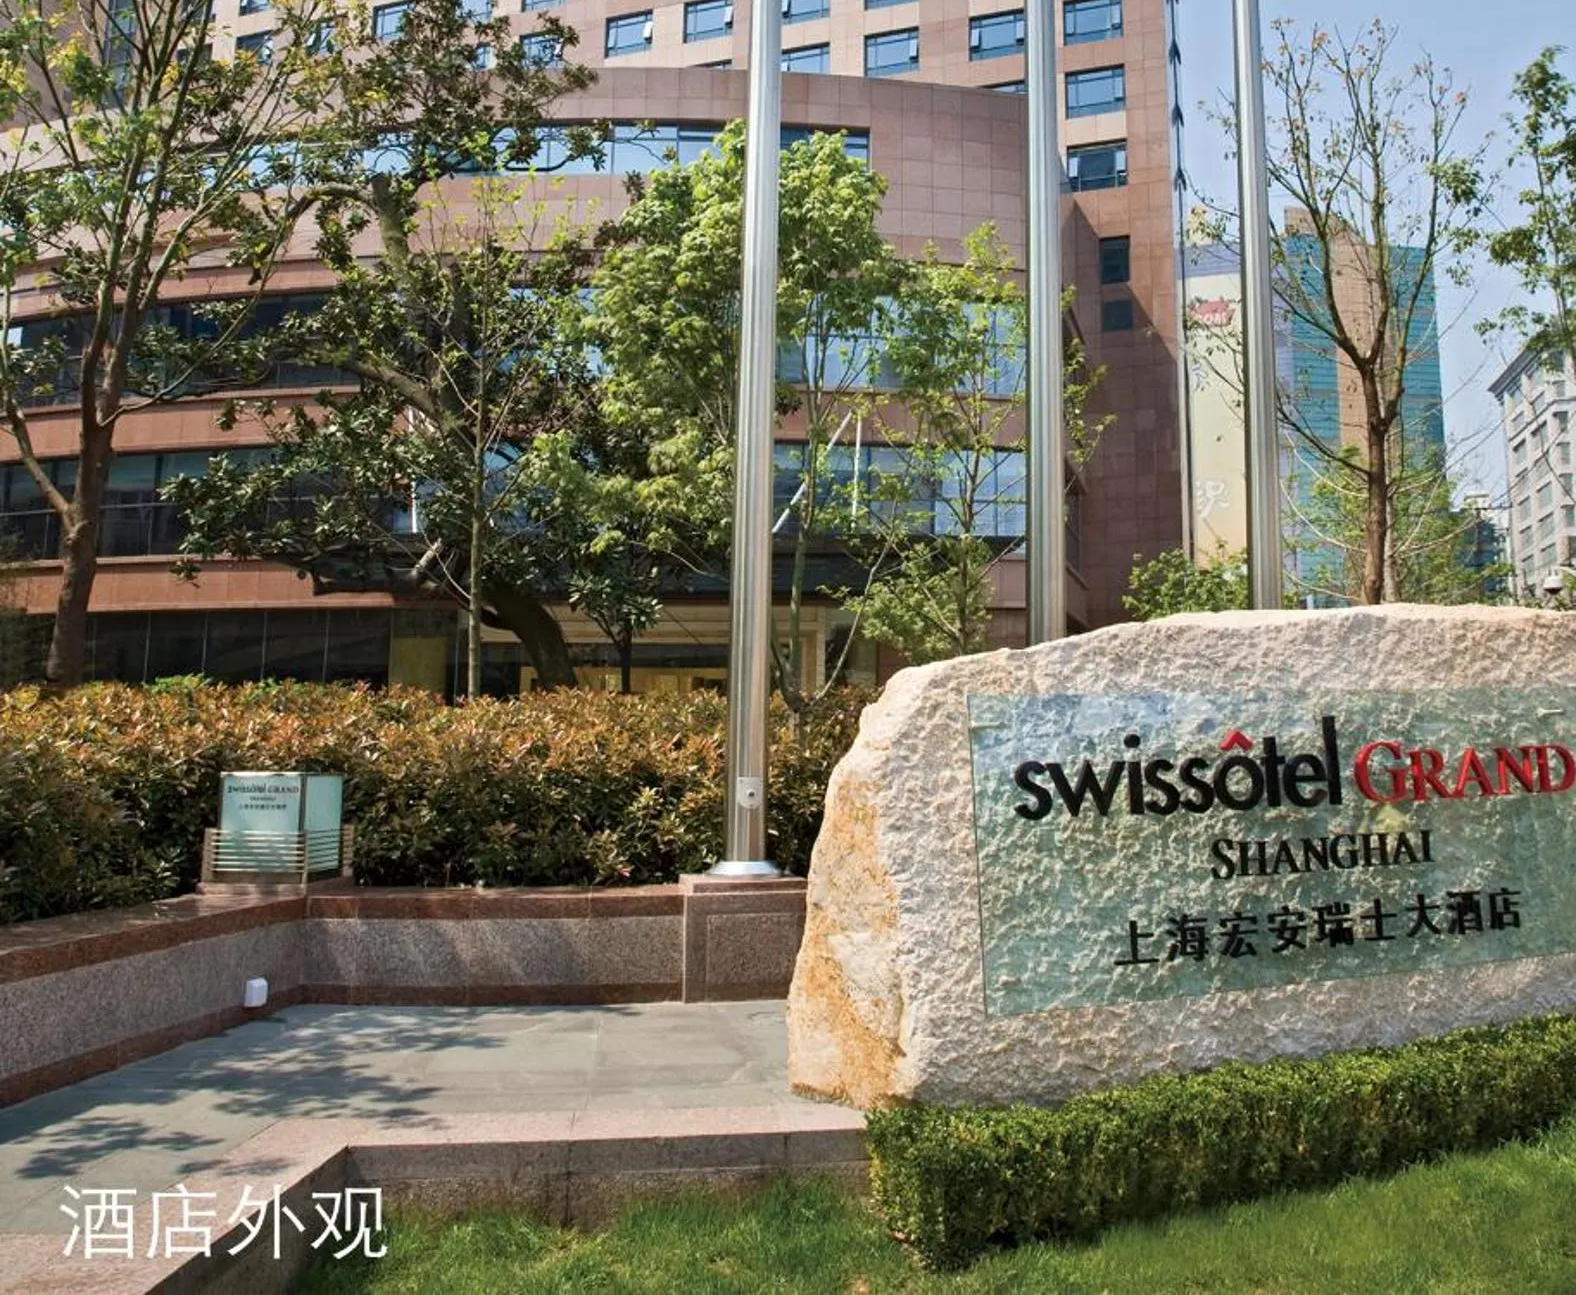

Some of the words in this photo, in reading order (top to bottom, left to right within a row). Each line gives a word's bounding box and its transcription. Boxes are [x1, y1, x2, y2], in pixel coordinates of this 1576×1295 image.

[1013, 715, 1343, 821] swissôtel
[1353, 740, 1576, 803] GRAND
[1211, 828, 1436, 880] SHANGHAI
[1113, 888, 1523, 966] 上海宏安瑞士大酒店
